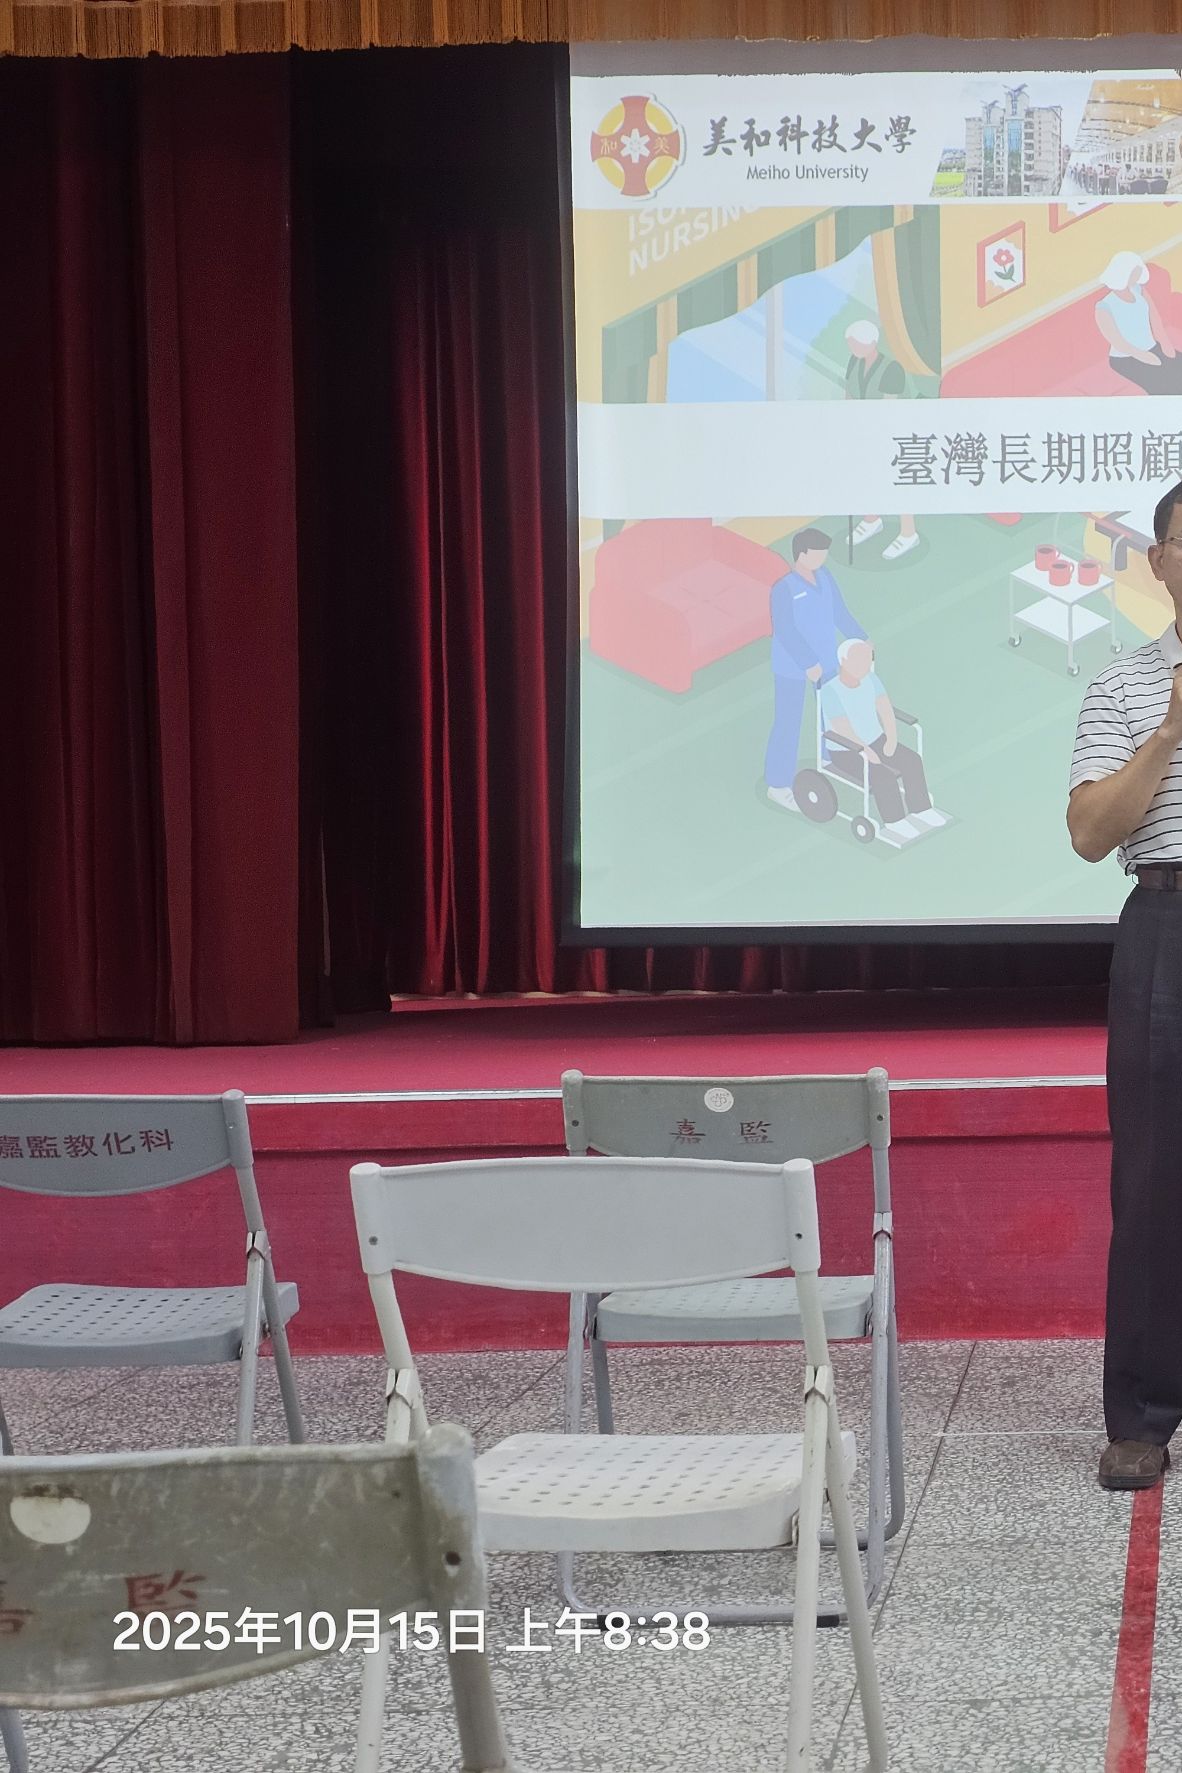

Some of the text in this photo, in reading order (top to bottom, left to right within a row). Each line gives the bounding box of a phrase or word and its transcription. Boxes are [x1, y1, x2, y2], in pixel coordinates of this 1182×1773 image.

[702, 114, 917, 157] 美和科技大學
[746, 164, 869, 183] Meiho University
